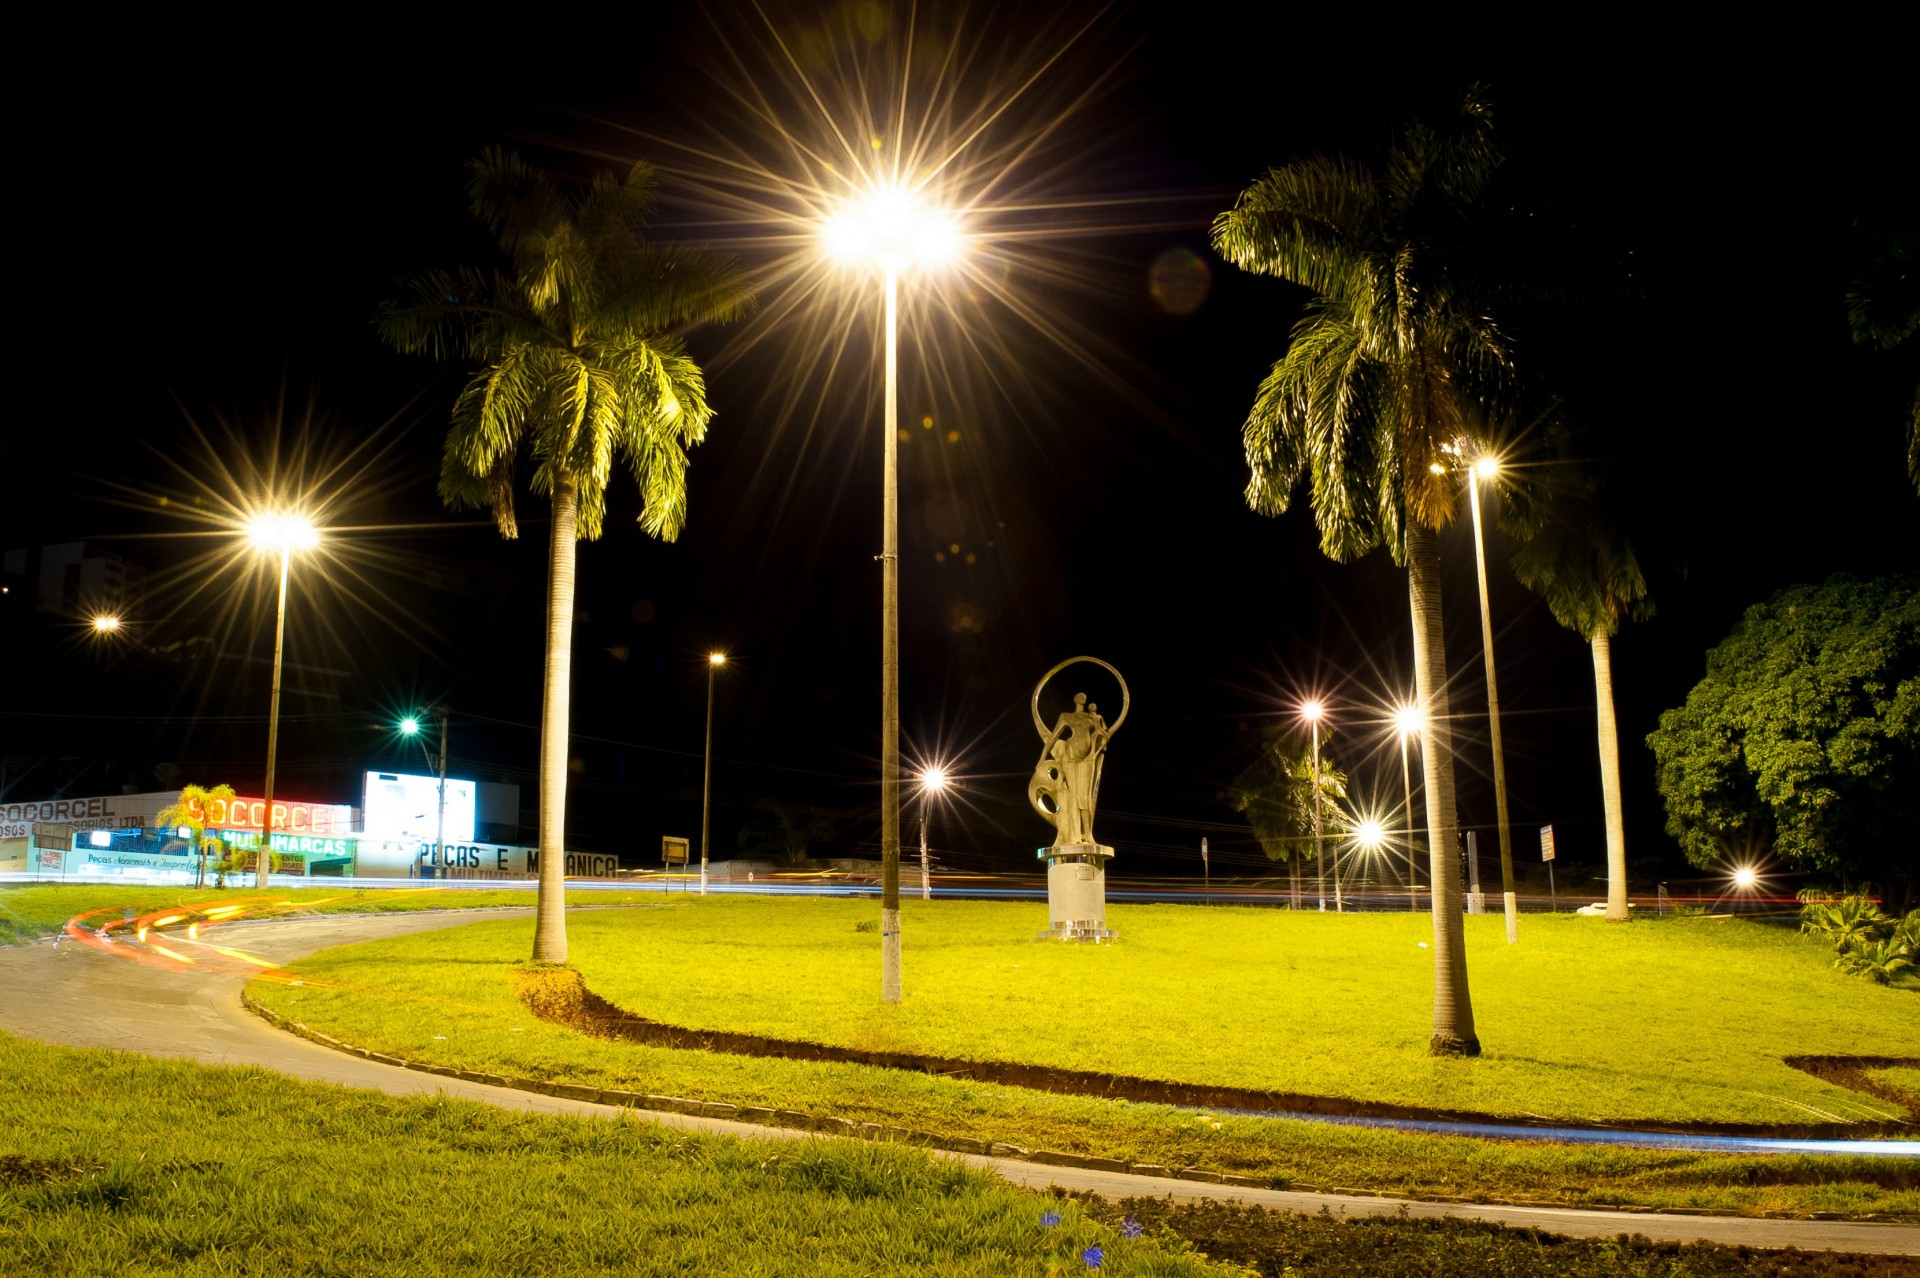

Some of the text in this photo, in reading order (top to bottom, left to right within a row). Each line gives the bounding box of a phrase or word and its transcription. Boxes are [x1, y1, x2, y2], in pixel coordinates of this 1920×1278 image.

[119, 816, 144, 828] LTDA
[189, 797, 349, 834] SOCORCEL
[222, 830, 347, 857] MULIMARCAS
[497, 848, 508, 871] E
[526, 850, 617, 878] MÂNICA
